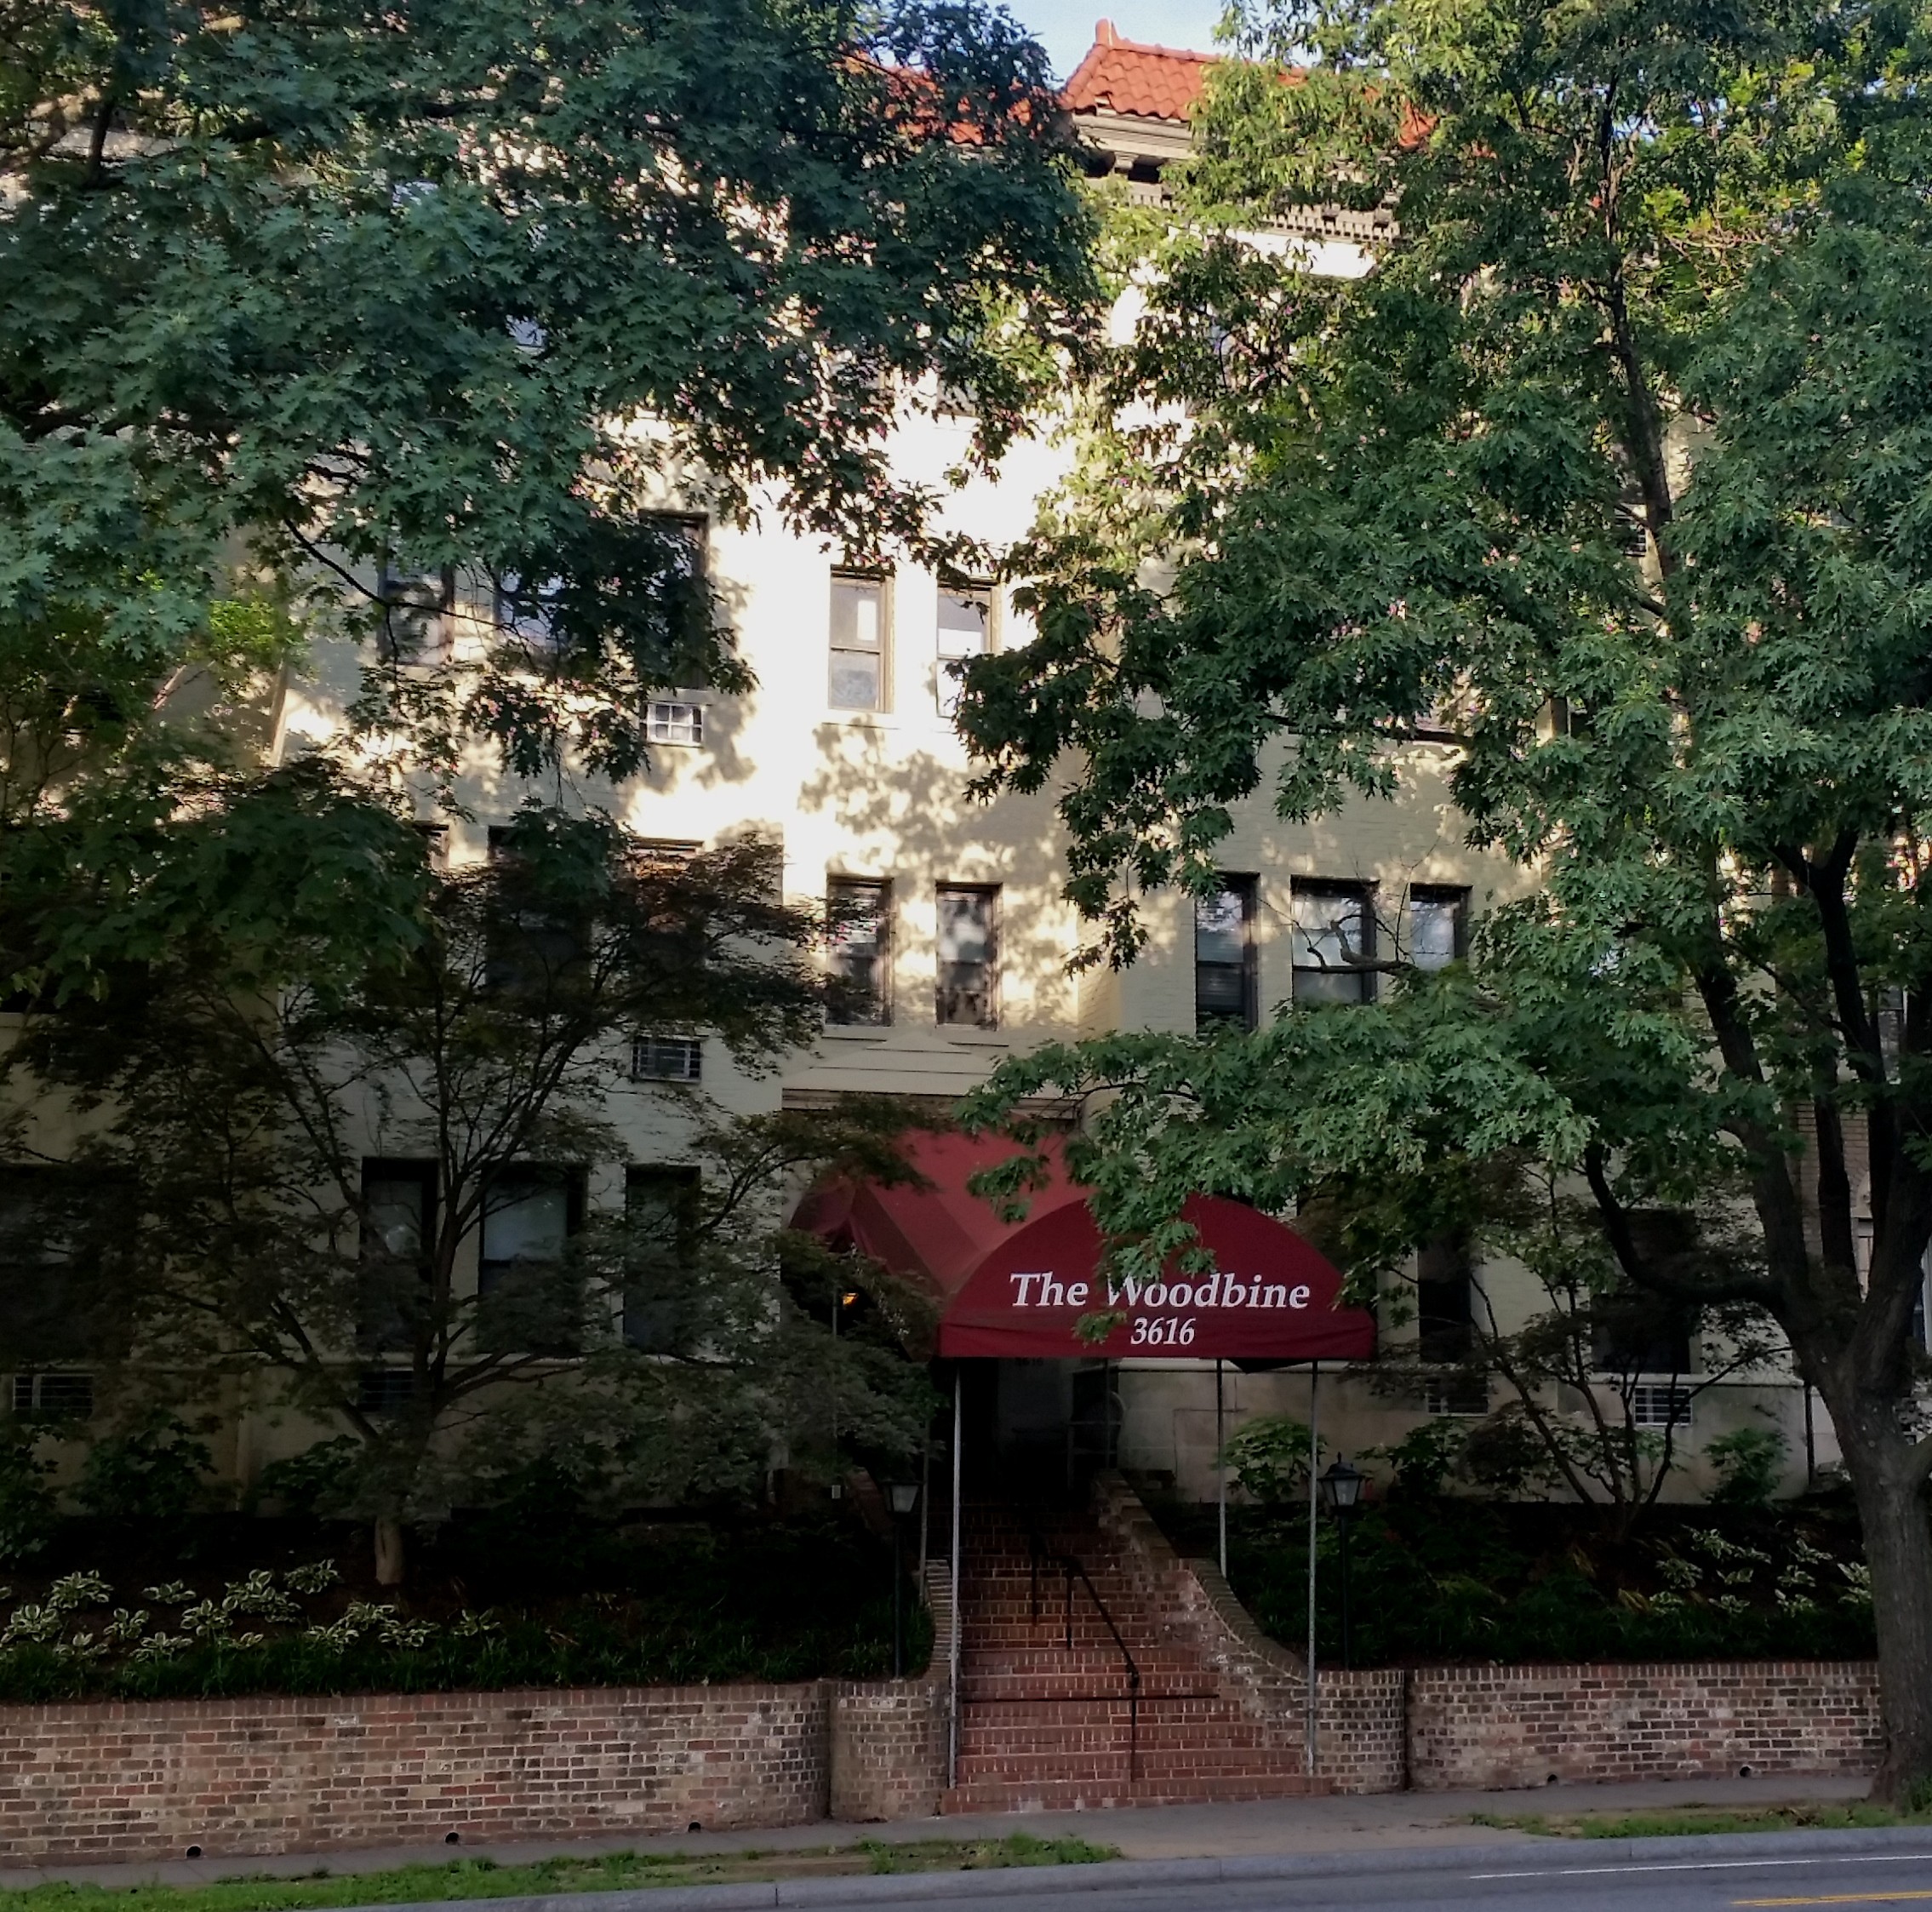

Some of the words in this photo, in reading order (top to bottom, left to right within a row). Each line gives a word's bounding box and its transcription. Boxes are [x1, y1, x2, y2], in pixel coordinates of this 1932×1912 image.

[1009, 1271, 1089, 1307] The
[1107, 1272, 1311, 1308] Woodbine
[1129, 1316, 1197, 1345] 3616
